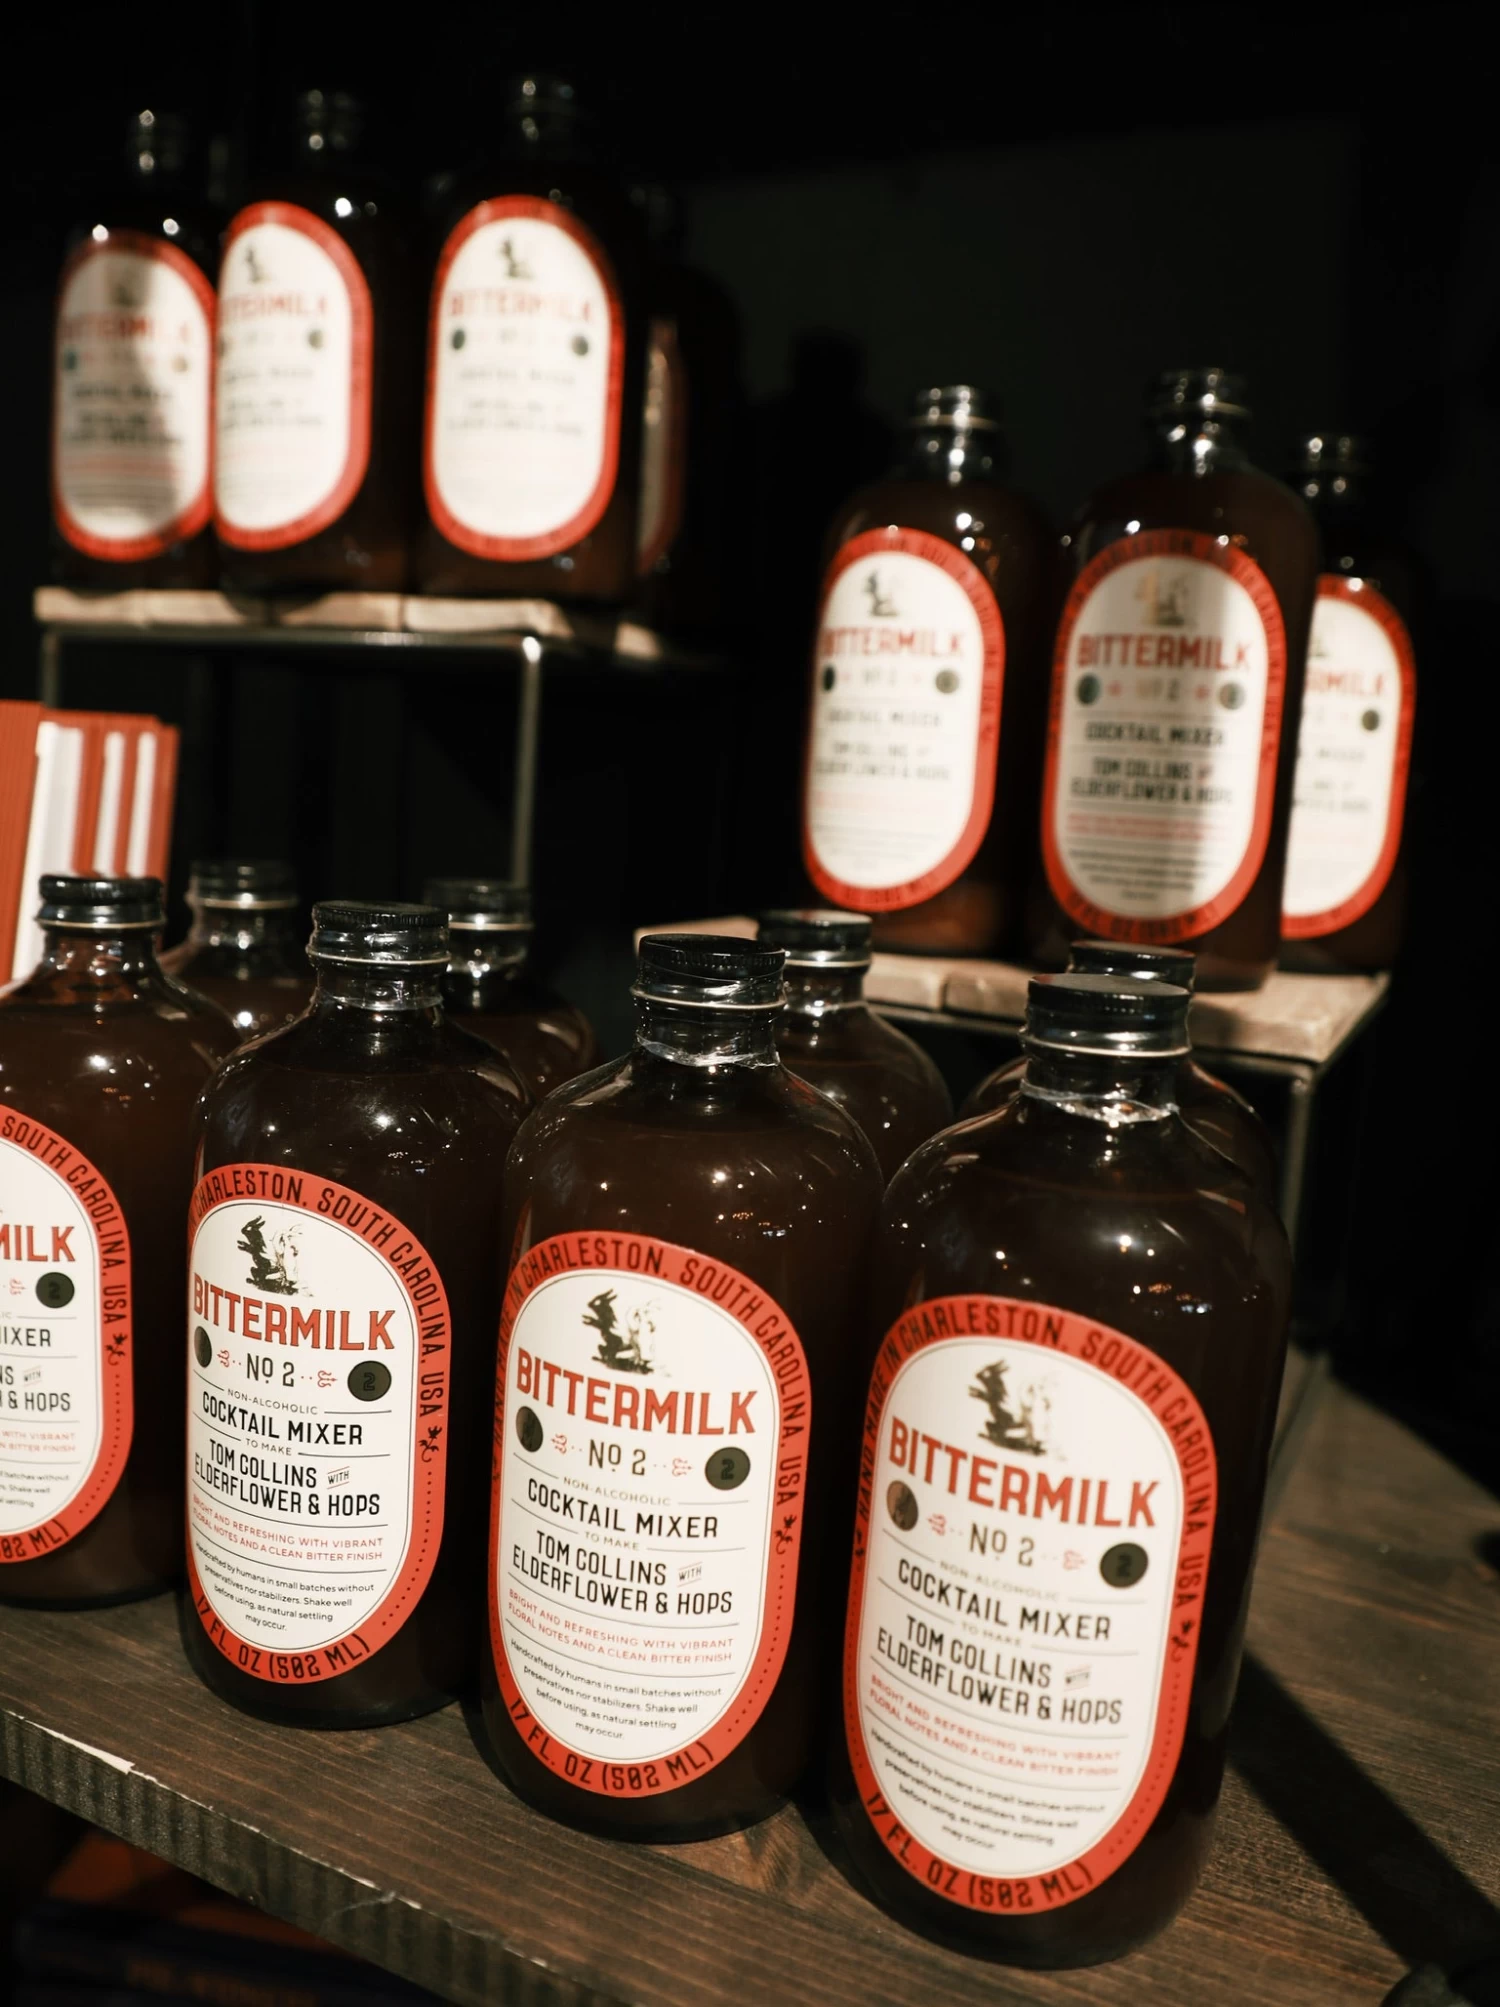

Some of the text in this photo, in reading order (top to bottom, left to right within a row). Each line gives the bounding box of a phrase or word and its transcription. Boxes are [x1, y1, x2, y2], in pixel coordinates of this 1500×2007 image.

[1076, 634, 1250, 670] BITTERMILK
[2, 1115, 73, 1170] SOUTH
[102, 1283, 128, 1325] USA
[193, 1273, 396, 1351] BITTERMILK
[317, 1187, 397, 1249] SOUTH
[419, 1371, 445, 1419] USA
[8, 1391, 71, 1411] & HOPS
[282, 1361, 295, 1387] 2
[363, 1372, 376, 1391] 2
[511, 1280, 525, 1299] IN
[679, 1257, 760, 1321] SOUTH
[776, 1454, 803, 1507] USA
[516, 1346, 758, 1435] BITTERMILK
[202, 1391, 363, 1446] COCKTAIL MIXER
[227, 1388, 318, 1416] NON-ALCOHOLIC
[210, 1439, 350, 1488] TOM COLLINS WITH
[246, 1438, 292, 1456] TO MAKE
[631, 1449, 646, 1476] 2
[883, 1340, 901, 1369] IN
[1079, 1330, 1172, 1402] SOUTH
[1175, 1553, 1206, 1609] USA
[889, 1416, 1160, 1528] BITTERMILK
[194, 1452, 380, 1517] ELDERFLOWER & HOPS
[528, 1477, 718, 1539] COCKTAIL MIXER
[563, 1476, 673, 1507] NON-ALCOHOLIC
[213, 1525, 238, 1544] NOTES
[240, 1538, 259, 1550] AND
[260, 1544, 268, 1553] A
[268, 1546, 303, 1559] CLEAN
[306, 1551, 344, 1561] BITTER
[347, 1551, 383, 1561] FINISH
[214, 1513, 231, 1526] AND
[233, 1521, 295, 1545] REFRESHING
[299, 1537, 329, 1549] WITH
[333, 1537, 384, 1549] VIBRANT
[536, 1530, 702, 1587] TOM COLLINS WITH
[584, 1531, 640, 1551] TO MAKE
[1019, 1536, 1036, 1567] 2
[227, 1564, 235, 1574] by
[236, 1566, 266, 1584] humans
[266, 1575, 274, 1585] in
[275, 1579, 299, 1590] small
[299, 1583, 337, 1593] batches
[337, 1583, 375, 1593] without
[244, 1586, 257, 1595] nor
[258, 1589, 301, 1605] stabilizers.
[303, 1597, 332, 1607] Shake
[333, 1598, 353, 1608] well
[513, 1544, 733, 1616] ELDERFLOWER & HOPS
[898, 1558, 1112, 1641] COCKTAIL MIXER
[197, 1594, 371, 1679] 17 FL. OZ (502 ML)
[245, 1613, 288, 1632] may occur.
[267, 1607, 297, 1618] natural
[299, 1611, 334, 1623] settling
[508, 1602, 732, 1664] FLORAL NOTES AND A CLEAN BITTER FINISH
[509, 1588, 734, 1650] BRIGHT AND REFRESHING WITH VIBRANT
[510, 1638, 722, 1698] Handcrafted by humans in small batches without
[878, 1627, 1123, 1725] ELDERFLOWER & HOPS
[906, 1615, 1053, 1689] TOM COLLINS
[523, 1665, 574, 1695] preservatives
[576, 1690, 591, 1701] nor
[644, 1703, 676, 1713] Shake
[678, 1703, 699, 1713] well
[536, 1686, 562, 1706] before
[590, 1711, 601, 1719] as
[602, 1713, 637, 1726] natural
[639, 1719, 677, 1731] settling
[509, 1698, 715, 1792] 17 FL. OZ (502 ML)
[575, 1721, 596, 1736] may
[867, 1791, 890, 1816] 17
[887, 1822, 918, 1870] FL.
[927, 1859, 957, 1896] OZ
[1042, 1860, 1093, 1900] ML)
